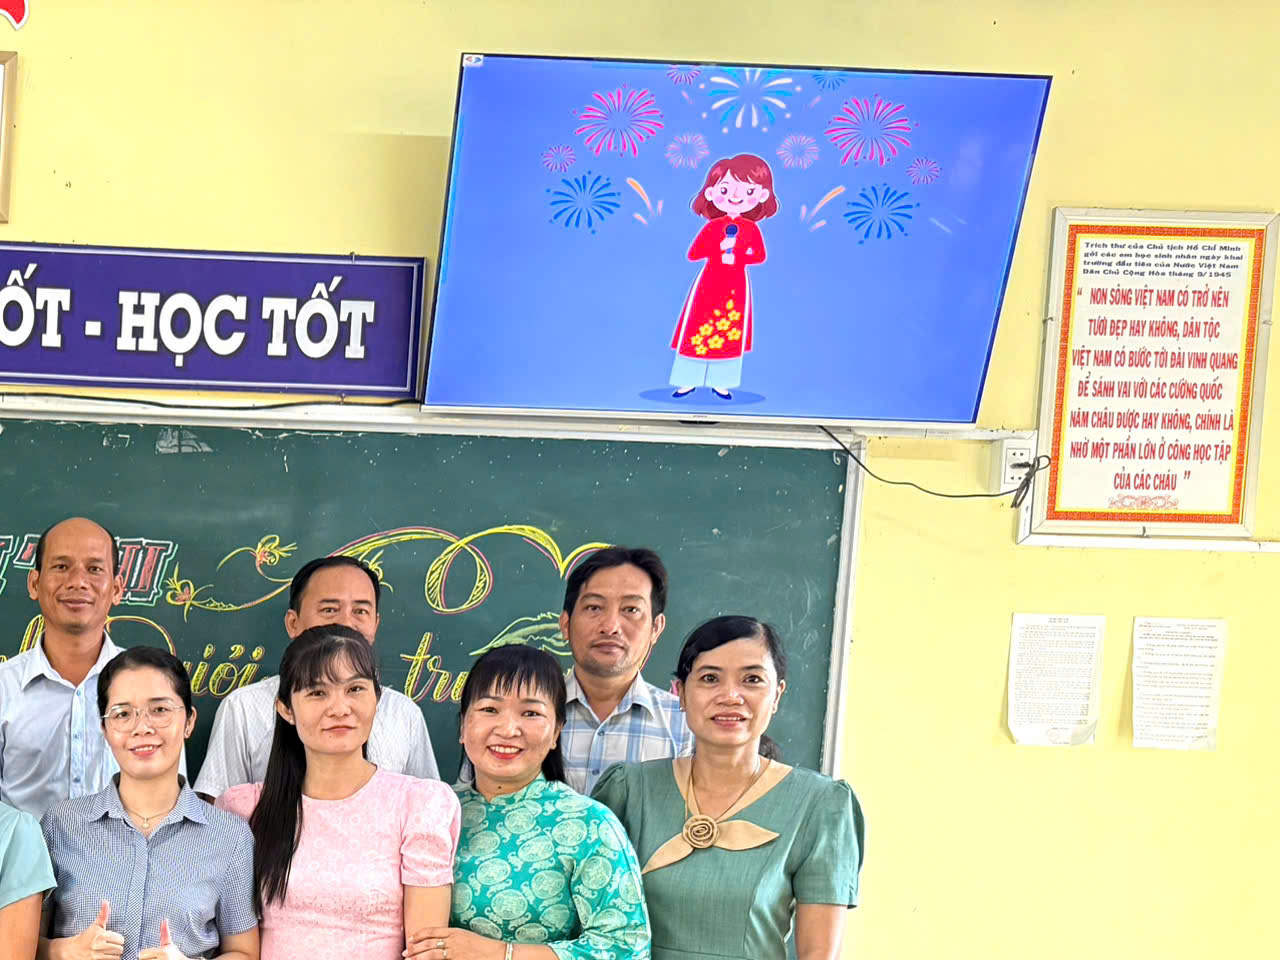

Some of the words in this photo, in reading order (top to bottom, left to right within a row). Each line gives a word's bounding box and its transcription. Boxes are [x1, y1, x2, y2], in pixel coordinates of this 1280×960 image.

[1089, 287, 1108, 305] NON
[1109, 284, 1133, 306] SÔNG
[1134, 284, 1154, 310] VIỆT
[1155, 289, 1176, 307] NAM
[1177, 285, 1189, 307] CÓ
[1192, 283, 1210, 308] TRỞ
[1211, 286, 1230, 308] NÊN
[84, 320, 102, 337] -
[116, 290, 248, 368] HỌC
[261, 275, 375, 360] TỐT
[1109, 319, 1128, 341] ĐẸP
[1129, 319, 1147, 337] HAY
[1148, 316, 1180, 341] KHÔNG,
[1182, 316, 1201, 338] DÂN
[1203, 317, 1221, 342] TỘC
[1072, 344, 1092, 370] VIỆT
[1093, 350, 1112, 367] NAM
[1114, 345, 1126, 367] CÓ
[1128, 346, 1152, 368] BƯỚC
[1154, 346, 1168, 369] TỚI
[1170, 347, 1185, 368] ĐÀI
[1187, 352, 1207, 369] VINH
[1209, 352, 1238, 373] QUANG
[1078, 371, 1092, 397] ĐỂ
[1092, 376, 1115, 398] SÁNH
[1117, 381, 1132, 398] VAI
[1133, 377, 1148, 398] VỚI
[1150, 377, 1167, 399] CÁC
[1199, 376, 1223, 403] QUỐC
[1070, 407, 1089, 428] NĂM
[1091, 406, 1114, 429] CHÂU
[1116, 408, 1140, 432] ĐƯỢC
[1141, 412, 1160, 430] HAY
[1161, 408, 1193, 433] KHÔNG,
[1195, 409, 1221, 431] CHÍNH
[1223, 409, 1234, 431] LÀ
[1070, 437, 1090, 459] NHỜ
[1090, 437, 1110, 463] MỘT
[1138, 438, 1156, 460] LỚN
[1158, 436, 1166, 460] Ở
[1167, 438, 1191, 461] CÔNG
[1193, 444, 1211, 465] HỌC
[1214, 440, 1232, 465] TẬP
[1114, 466, 1131, 490] CỦA
[1133, 468, 1151, 491] CÁC
[1153, 469, 1178, 491] CHÁU
